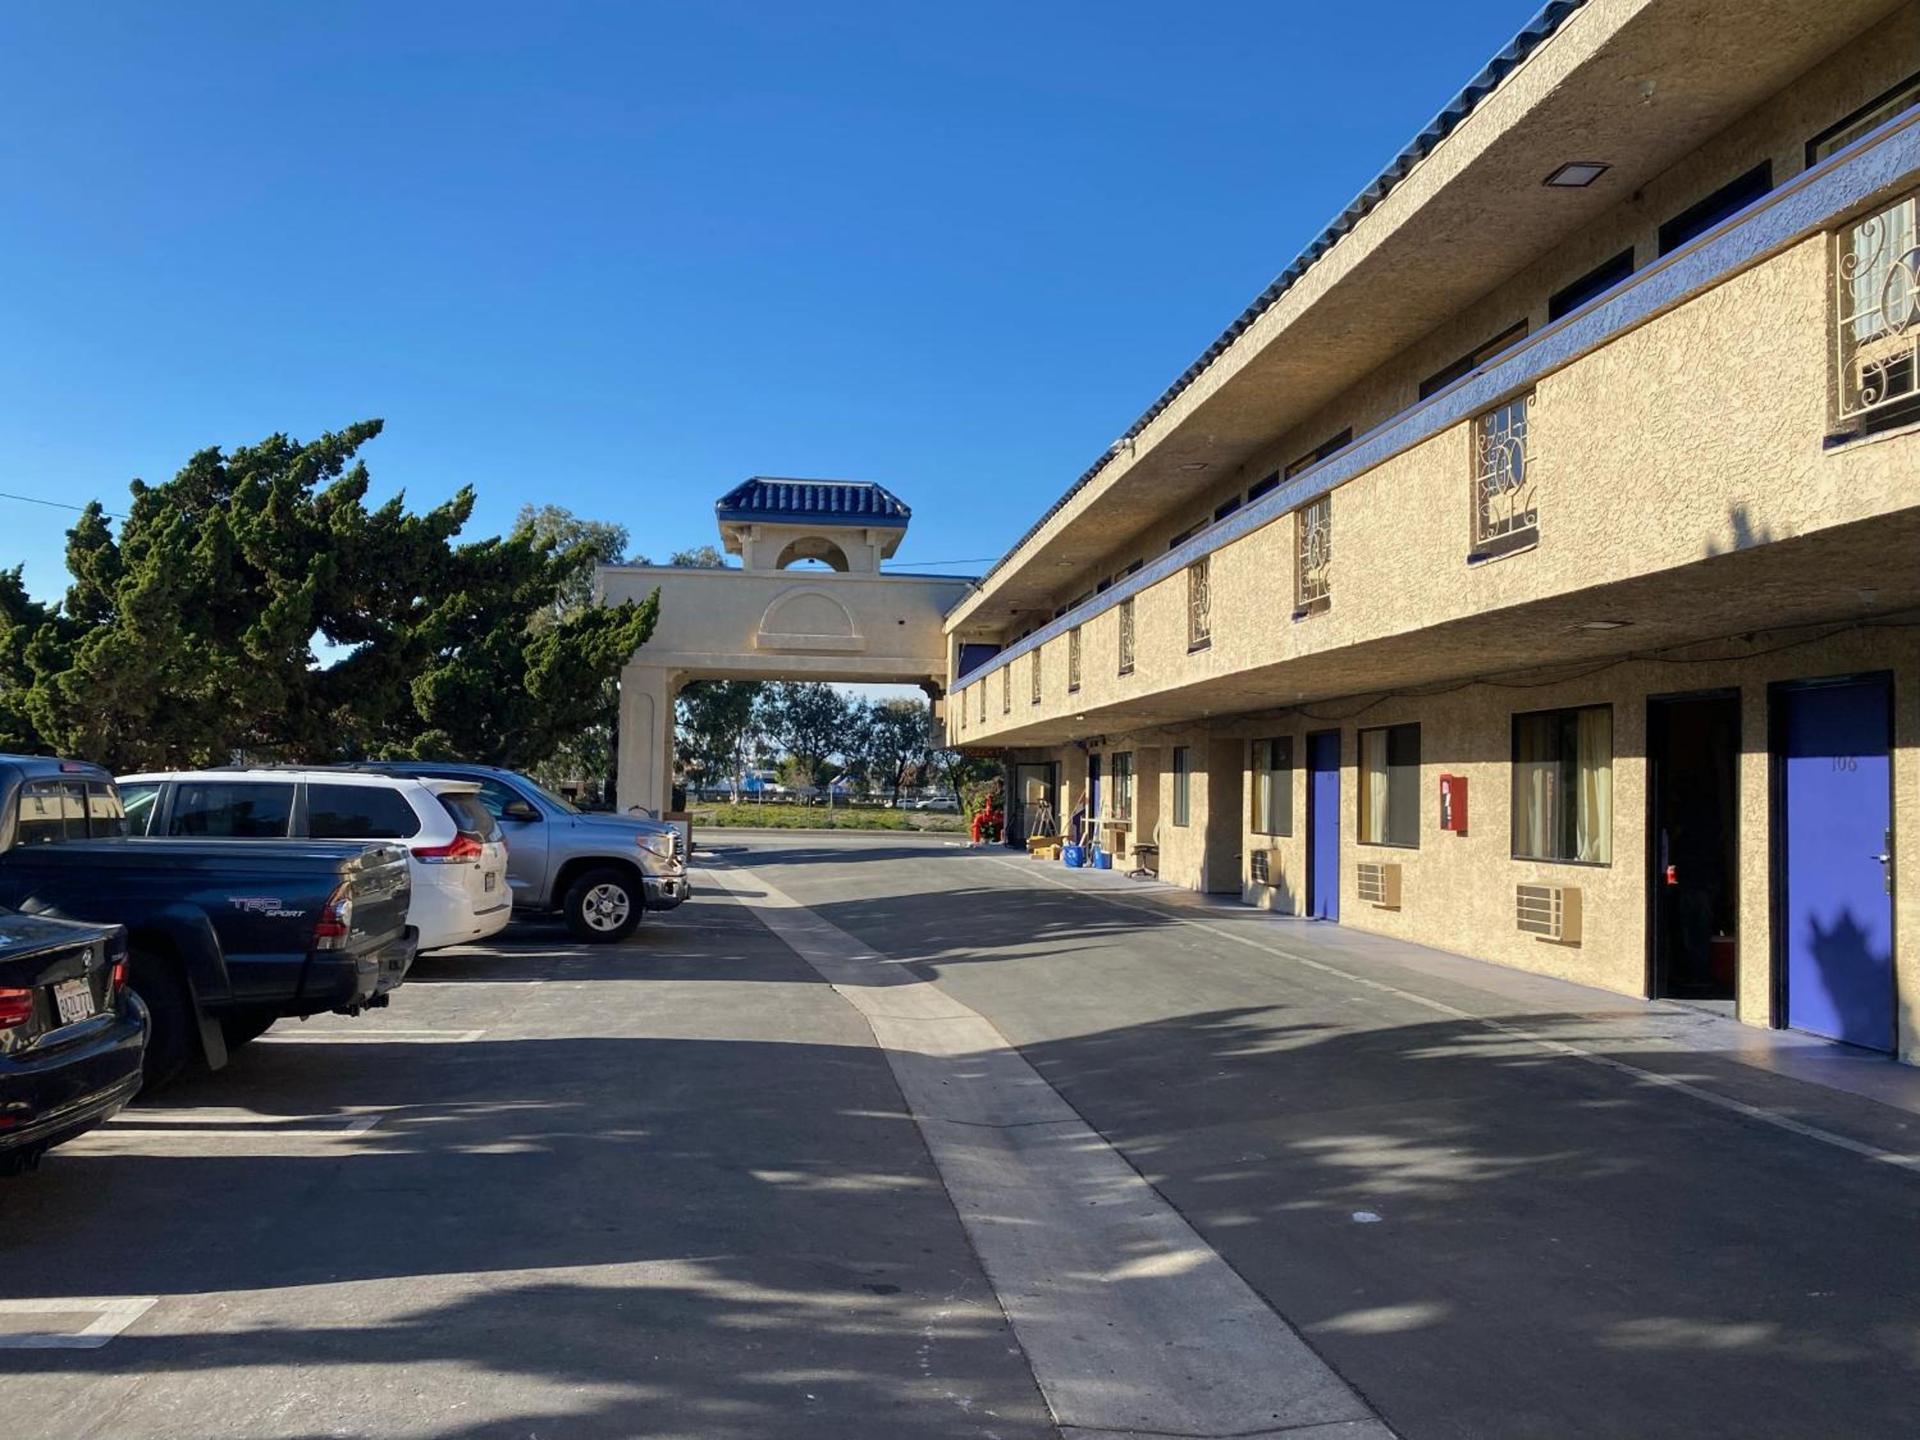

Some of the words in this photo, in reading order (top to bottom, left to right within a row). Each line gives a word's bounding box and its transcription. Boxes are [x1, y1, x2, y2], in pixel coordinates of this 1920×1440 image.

[1832, 755, 1857, 772] 106
[228, 897, 282, 912] TRD
[265, 909, 306, 918] SPORT
